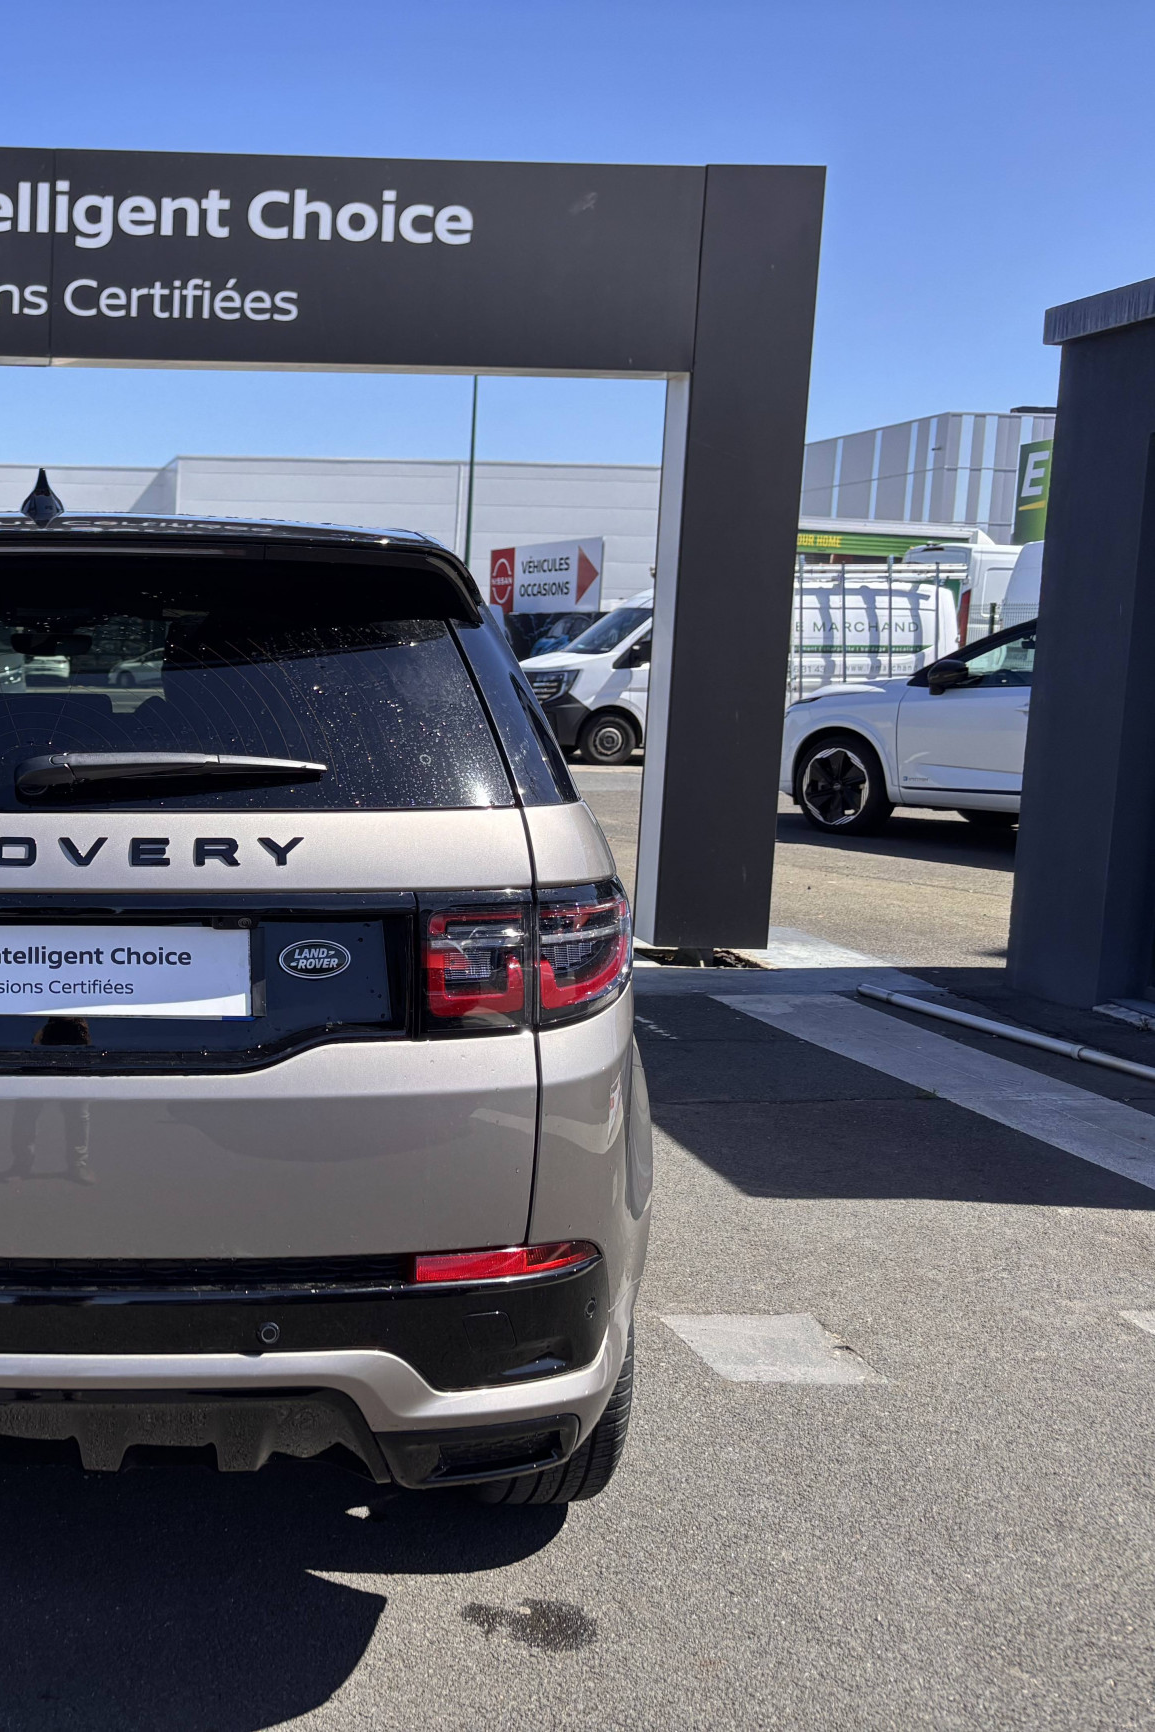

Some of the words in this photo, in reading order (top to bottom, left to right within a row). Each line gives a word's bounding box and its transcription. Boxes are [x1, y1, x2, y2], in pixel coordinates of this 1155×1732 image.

[246, 187, 475, 246] Choice
[62, 277, 300, 322] Certifiées
[816, 535, 843, 548] HOME
[521, 556, 571, 575] VÉHICULES
[491, 576, 513, 586] NISSAN
[519, 581, 571, 598] OCCASIONS
[812, 621, 920, 633] MARCHAND
[110, 947, 193, 966] Choice
[293, 948, 328, 959] LAND
[297, 958, 339, 970] ROVER
[48, 978, 135, 995] Certifiées
